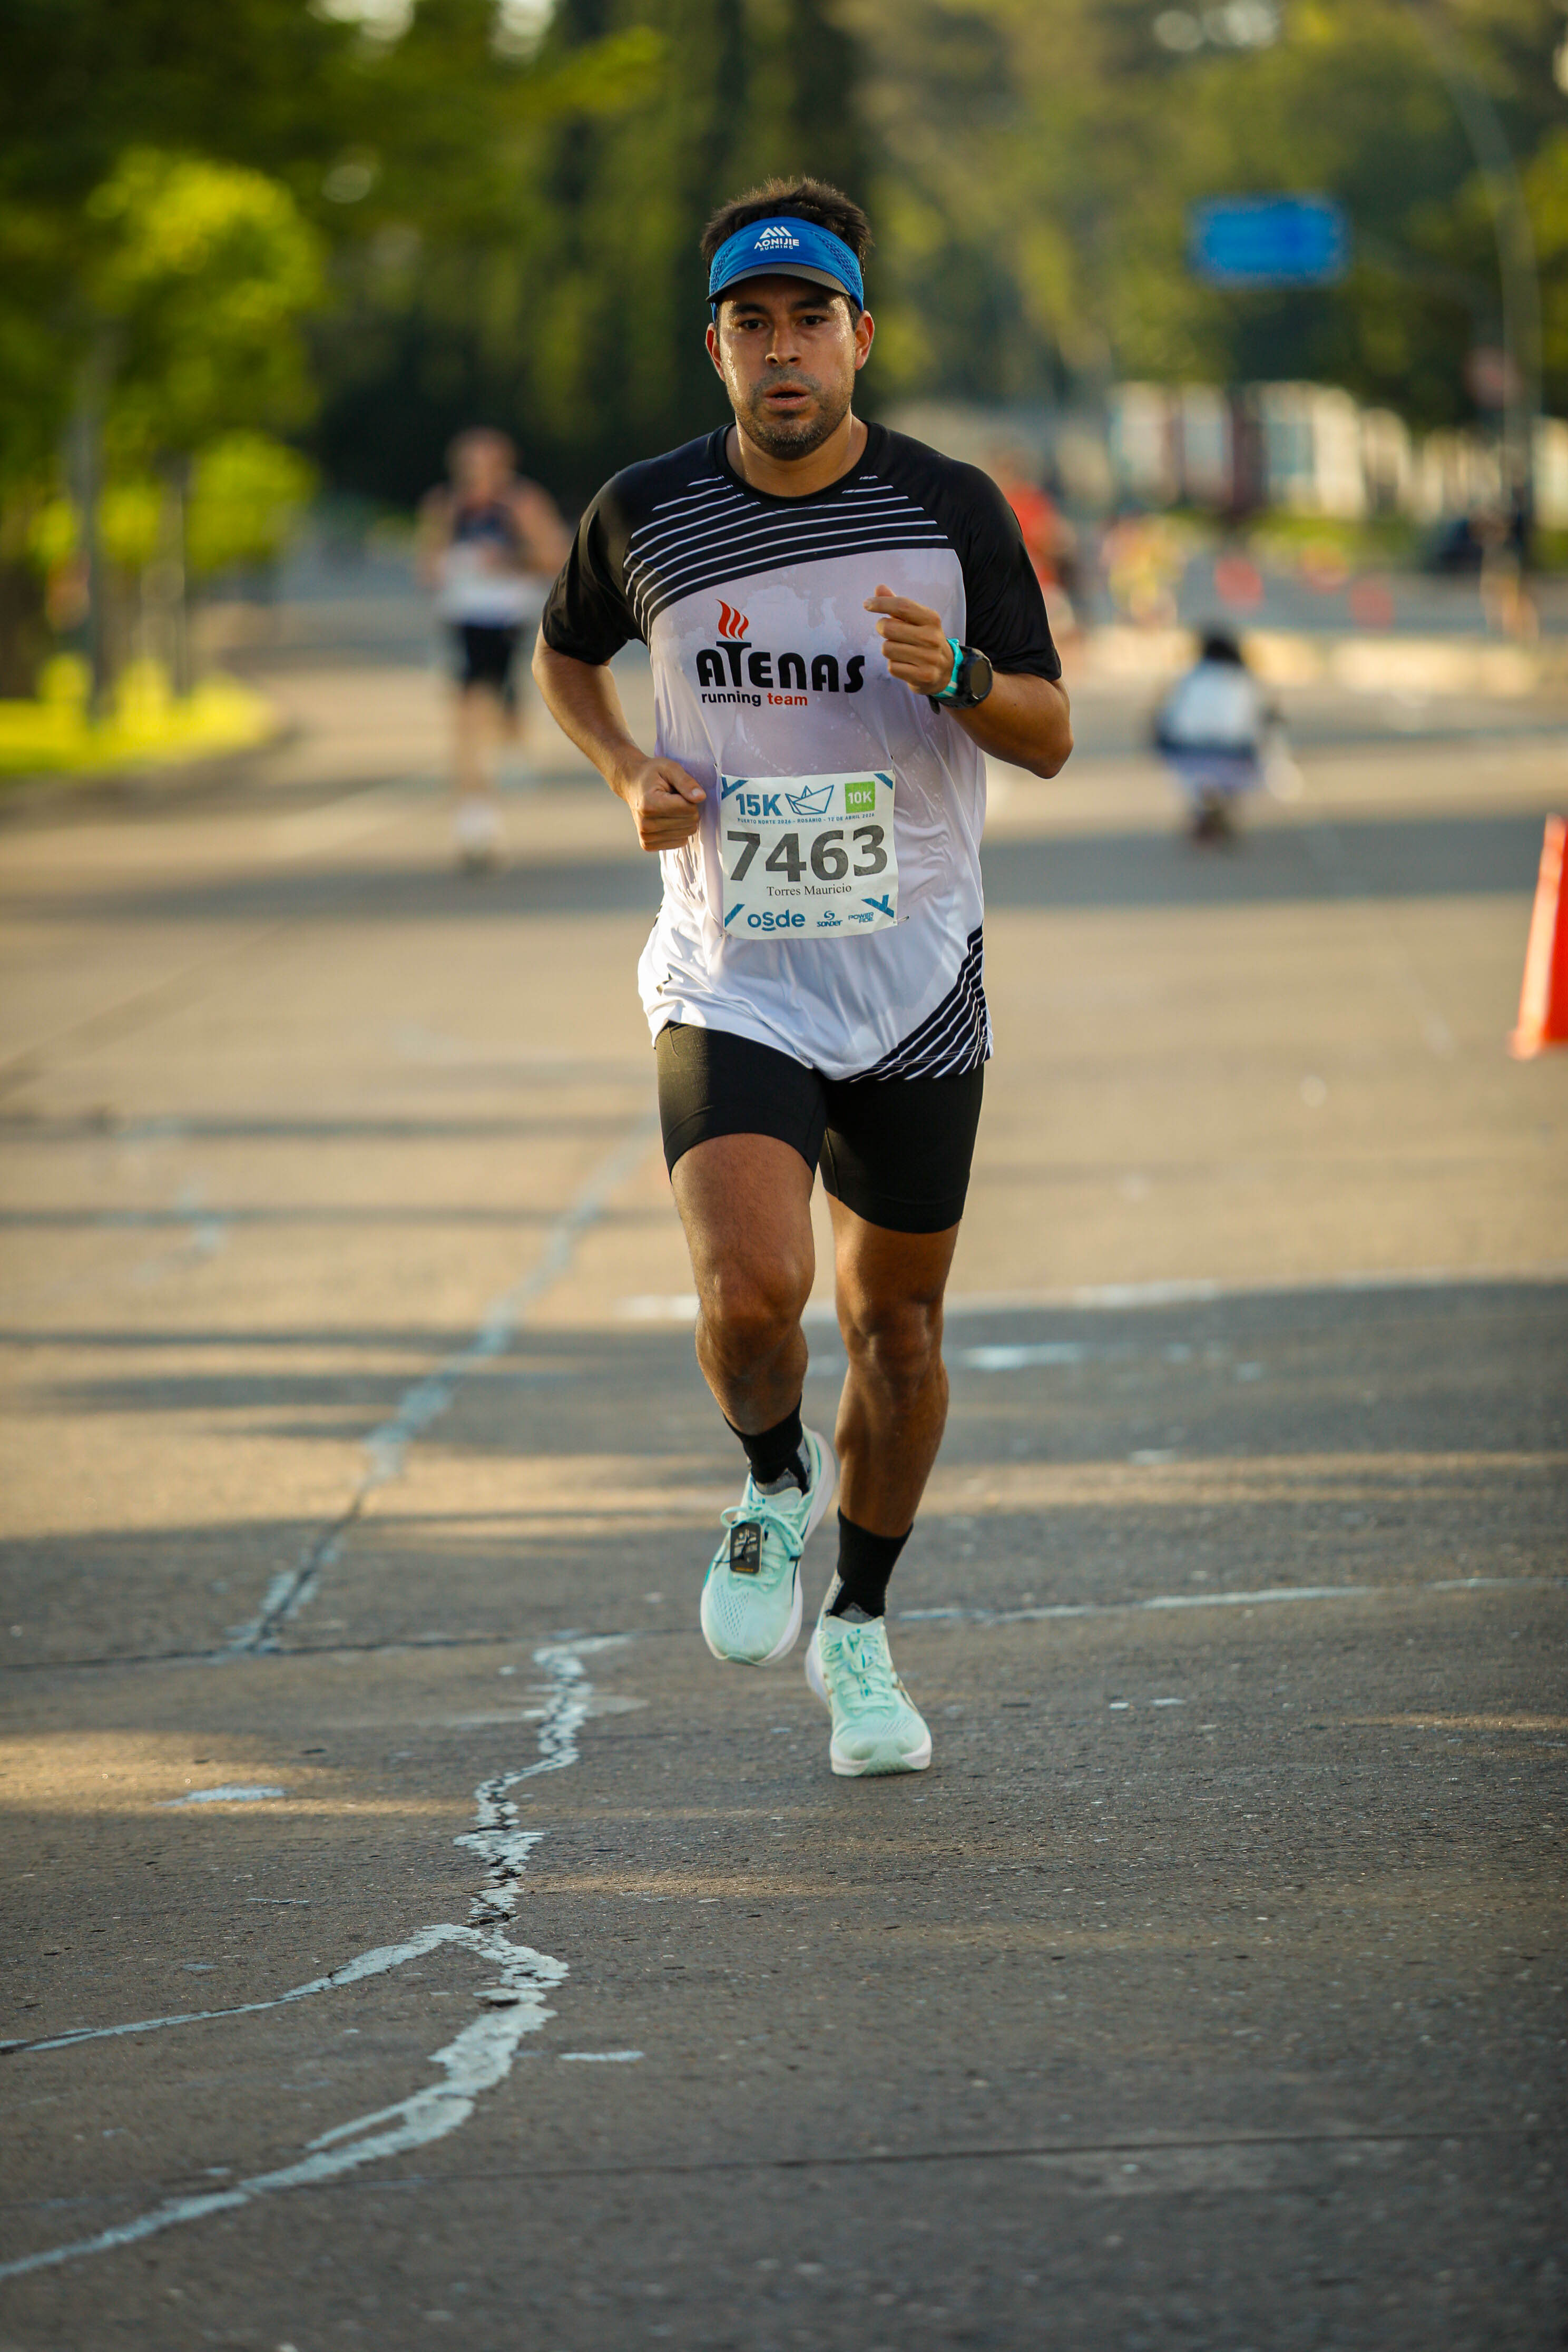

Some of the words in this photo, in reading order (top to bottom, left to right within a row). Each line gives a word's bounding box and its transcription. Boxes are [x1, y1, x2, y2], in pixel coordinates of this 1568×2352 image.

[695, 641, 865, 693] ATENAS
[702, 690, 761, 707] running
[767, 692, 808, 706] team
[736, 793, 783, 816] 15K
[848, 790, 872, 804] 10K
[727, 825, 887, 882] 7463
[766, 886, 801, 896] Torres
[804, 883, 852, 895] Mauricio
[747, 909, 806, 930] osde
[848, 912, 874, 920] POWER
